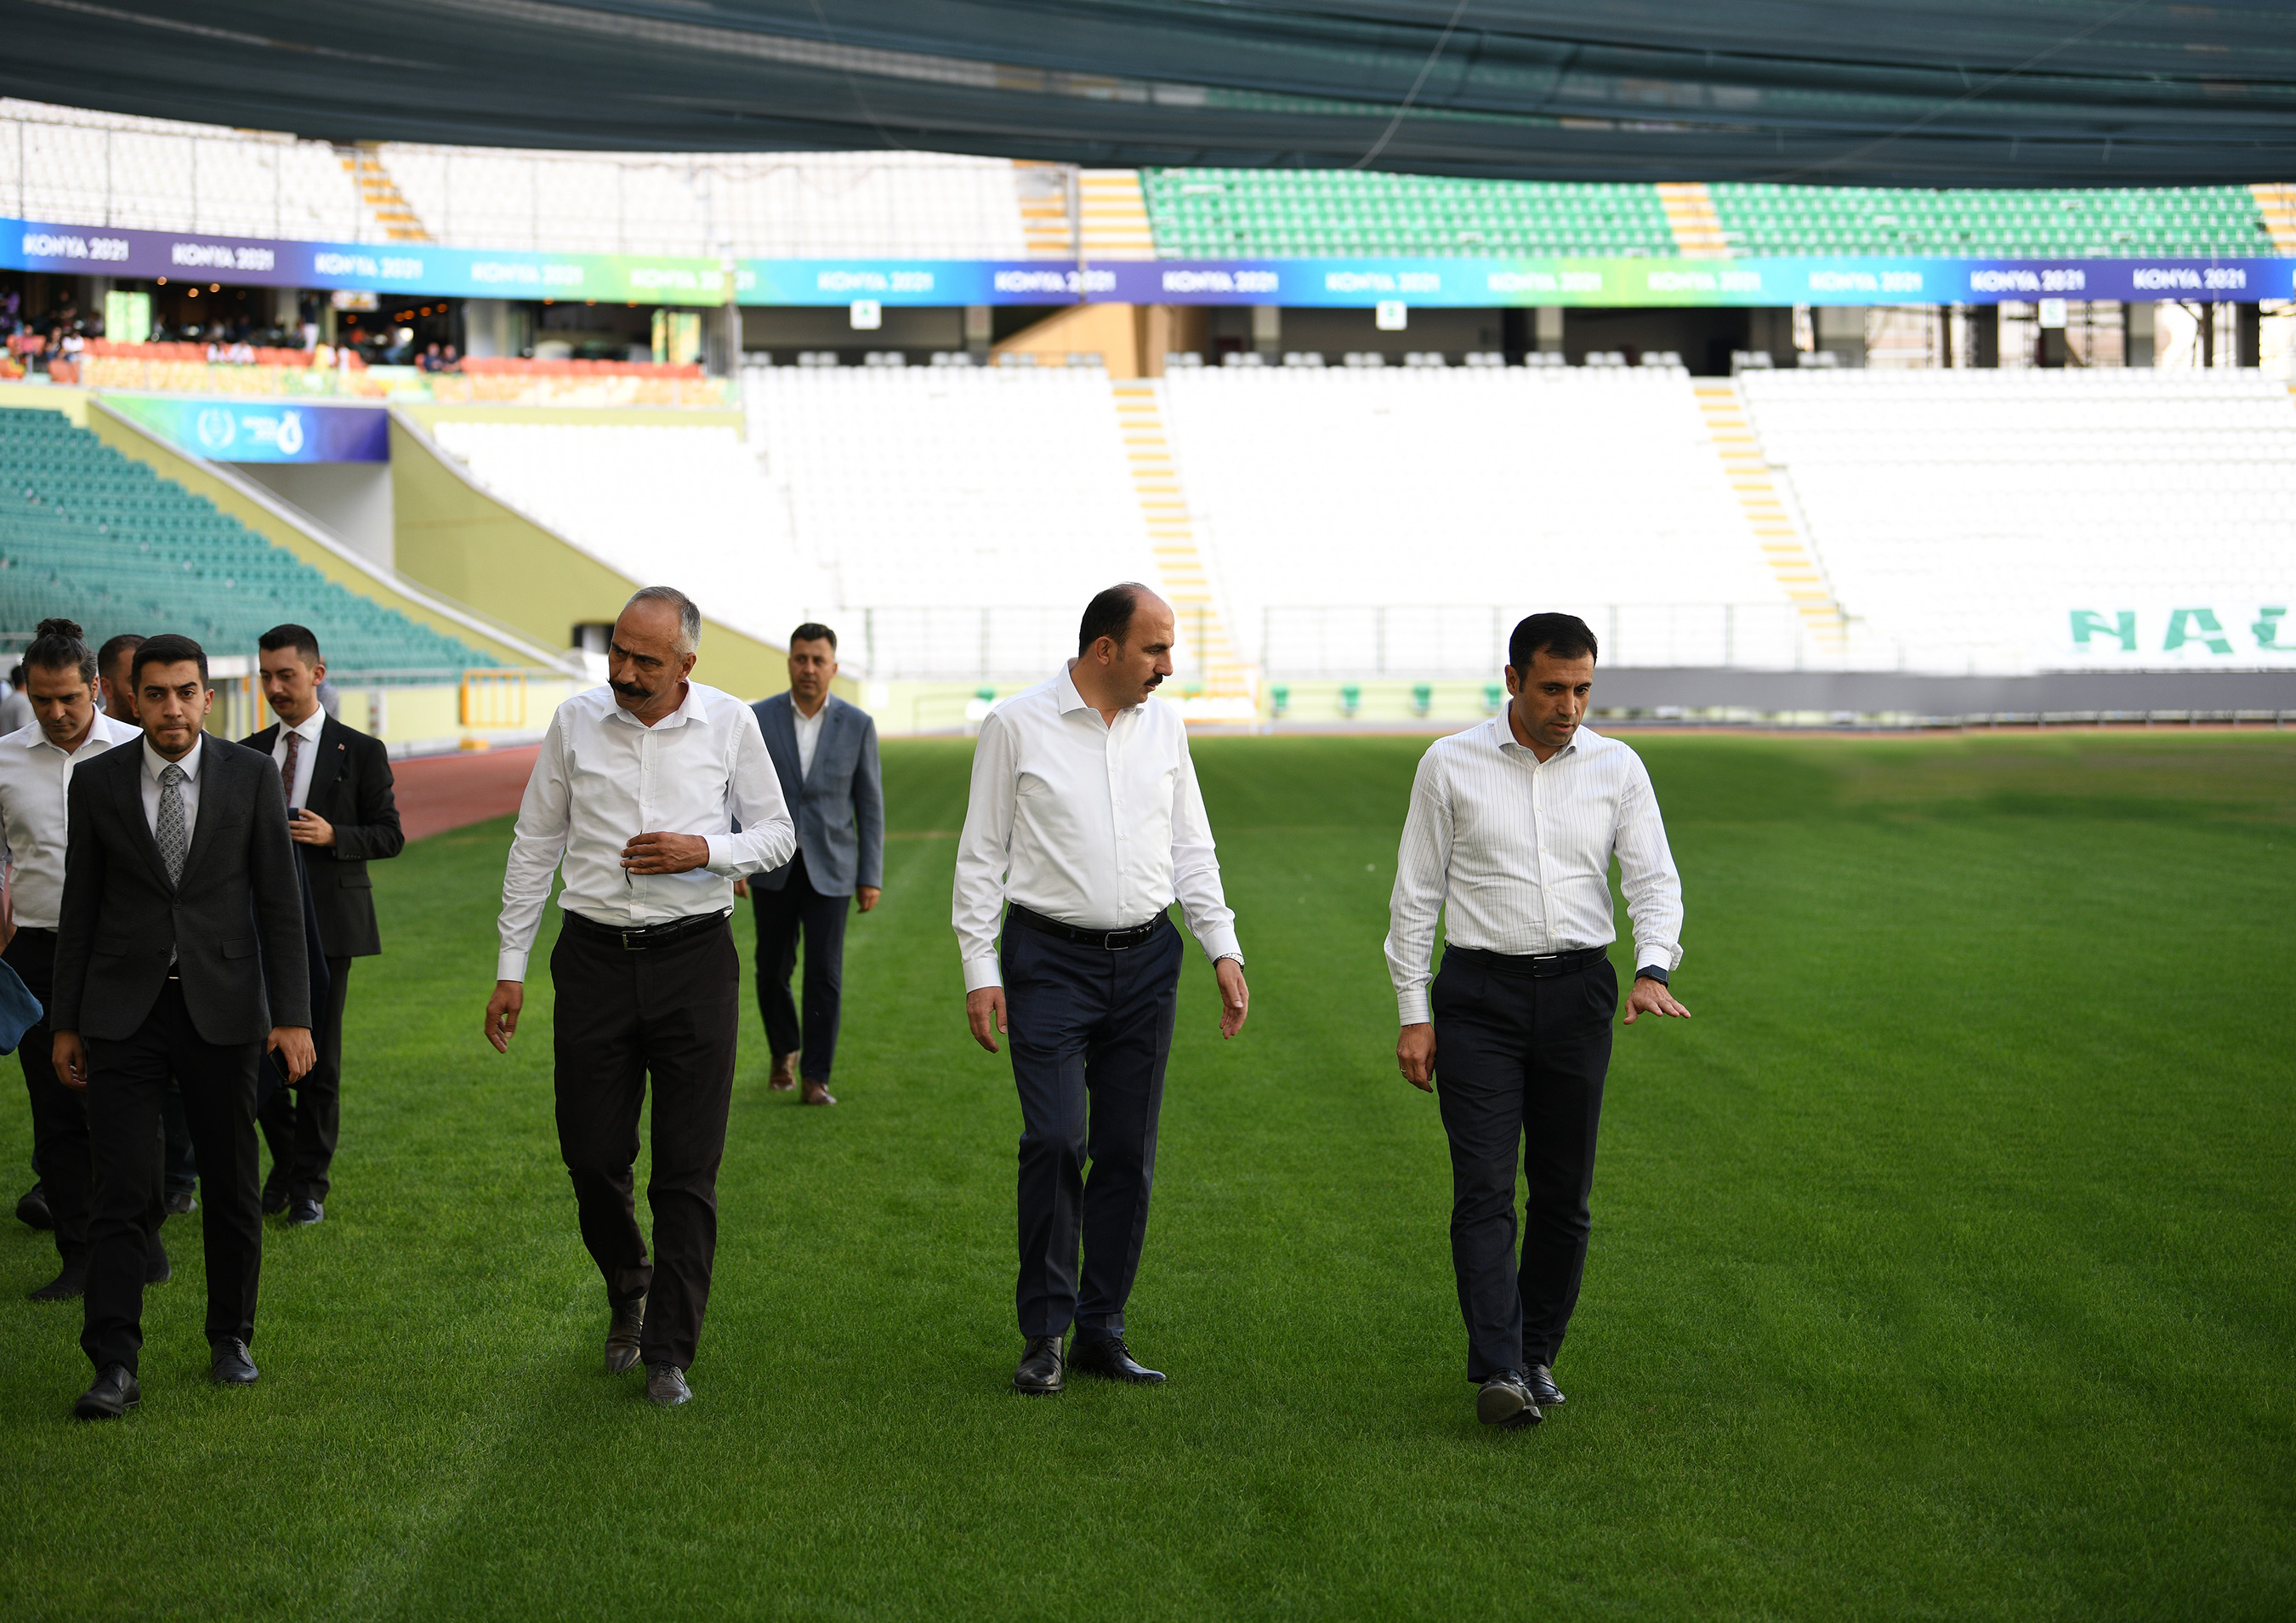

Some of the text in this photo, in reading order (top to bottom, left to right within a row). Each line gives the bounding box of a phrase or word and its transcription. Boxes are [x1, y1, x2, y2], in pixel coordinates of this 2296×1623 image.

[23, 233, 129, 262] KONYA 2021
[172, 242, 275, 271] KONYA 2021
[315, 253, 423, 280] KONYA 2021
[995, 271, 1066, 293] KONYA
[1162, 271, 1234, 293] KONYA
[1809, 270, 1924, 292] KONYA 2021
[1970, 269, 2085, 292] KONYA 2021
[2133, 268, 2247, 289] KONYA 2021
